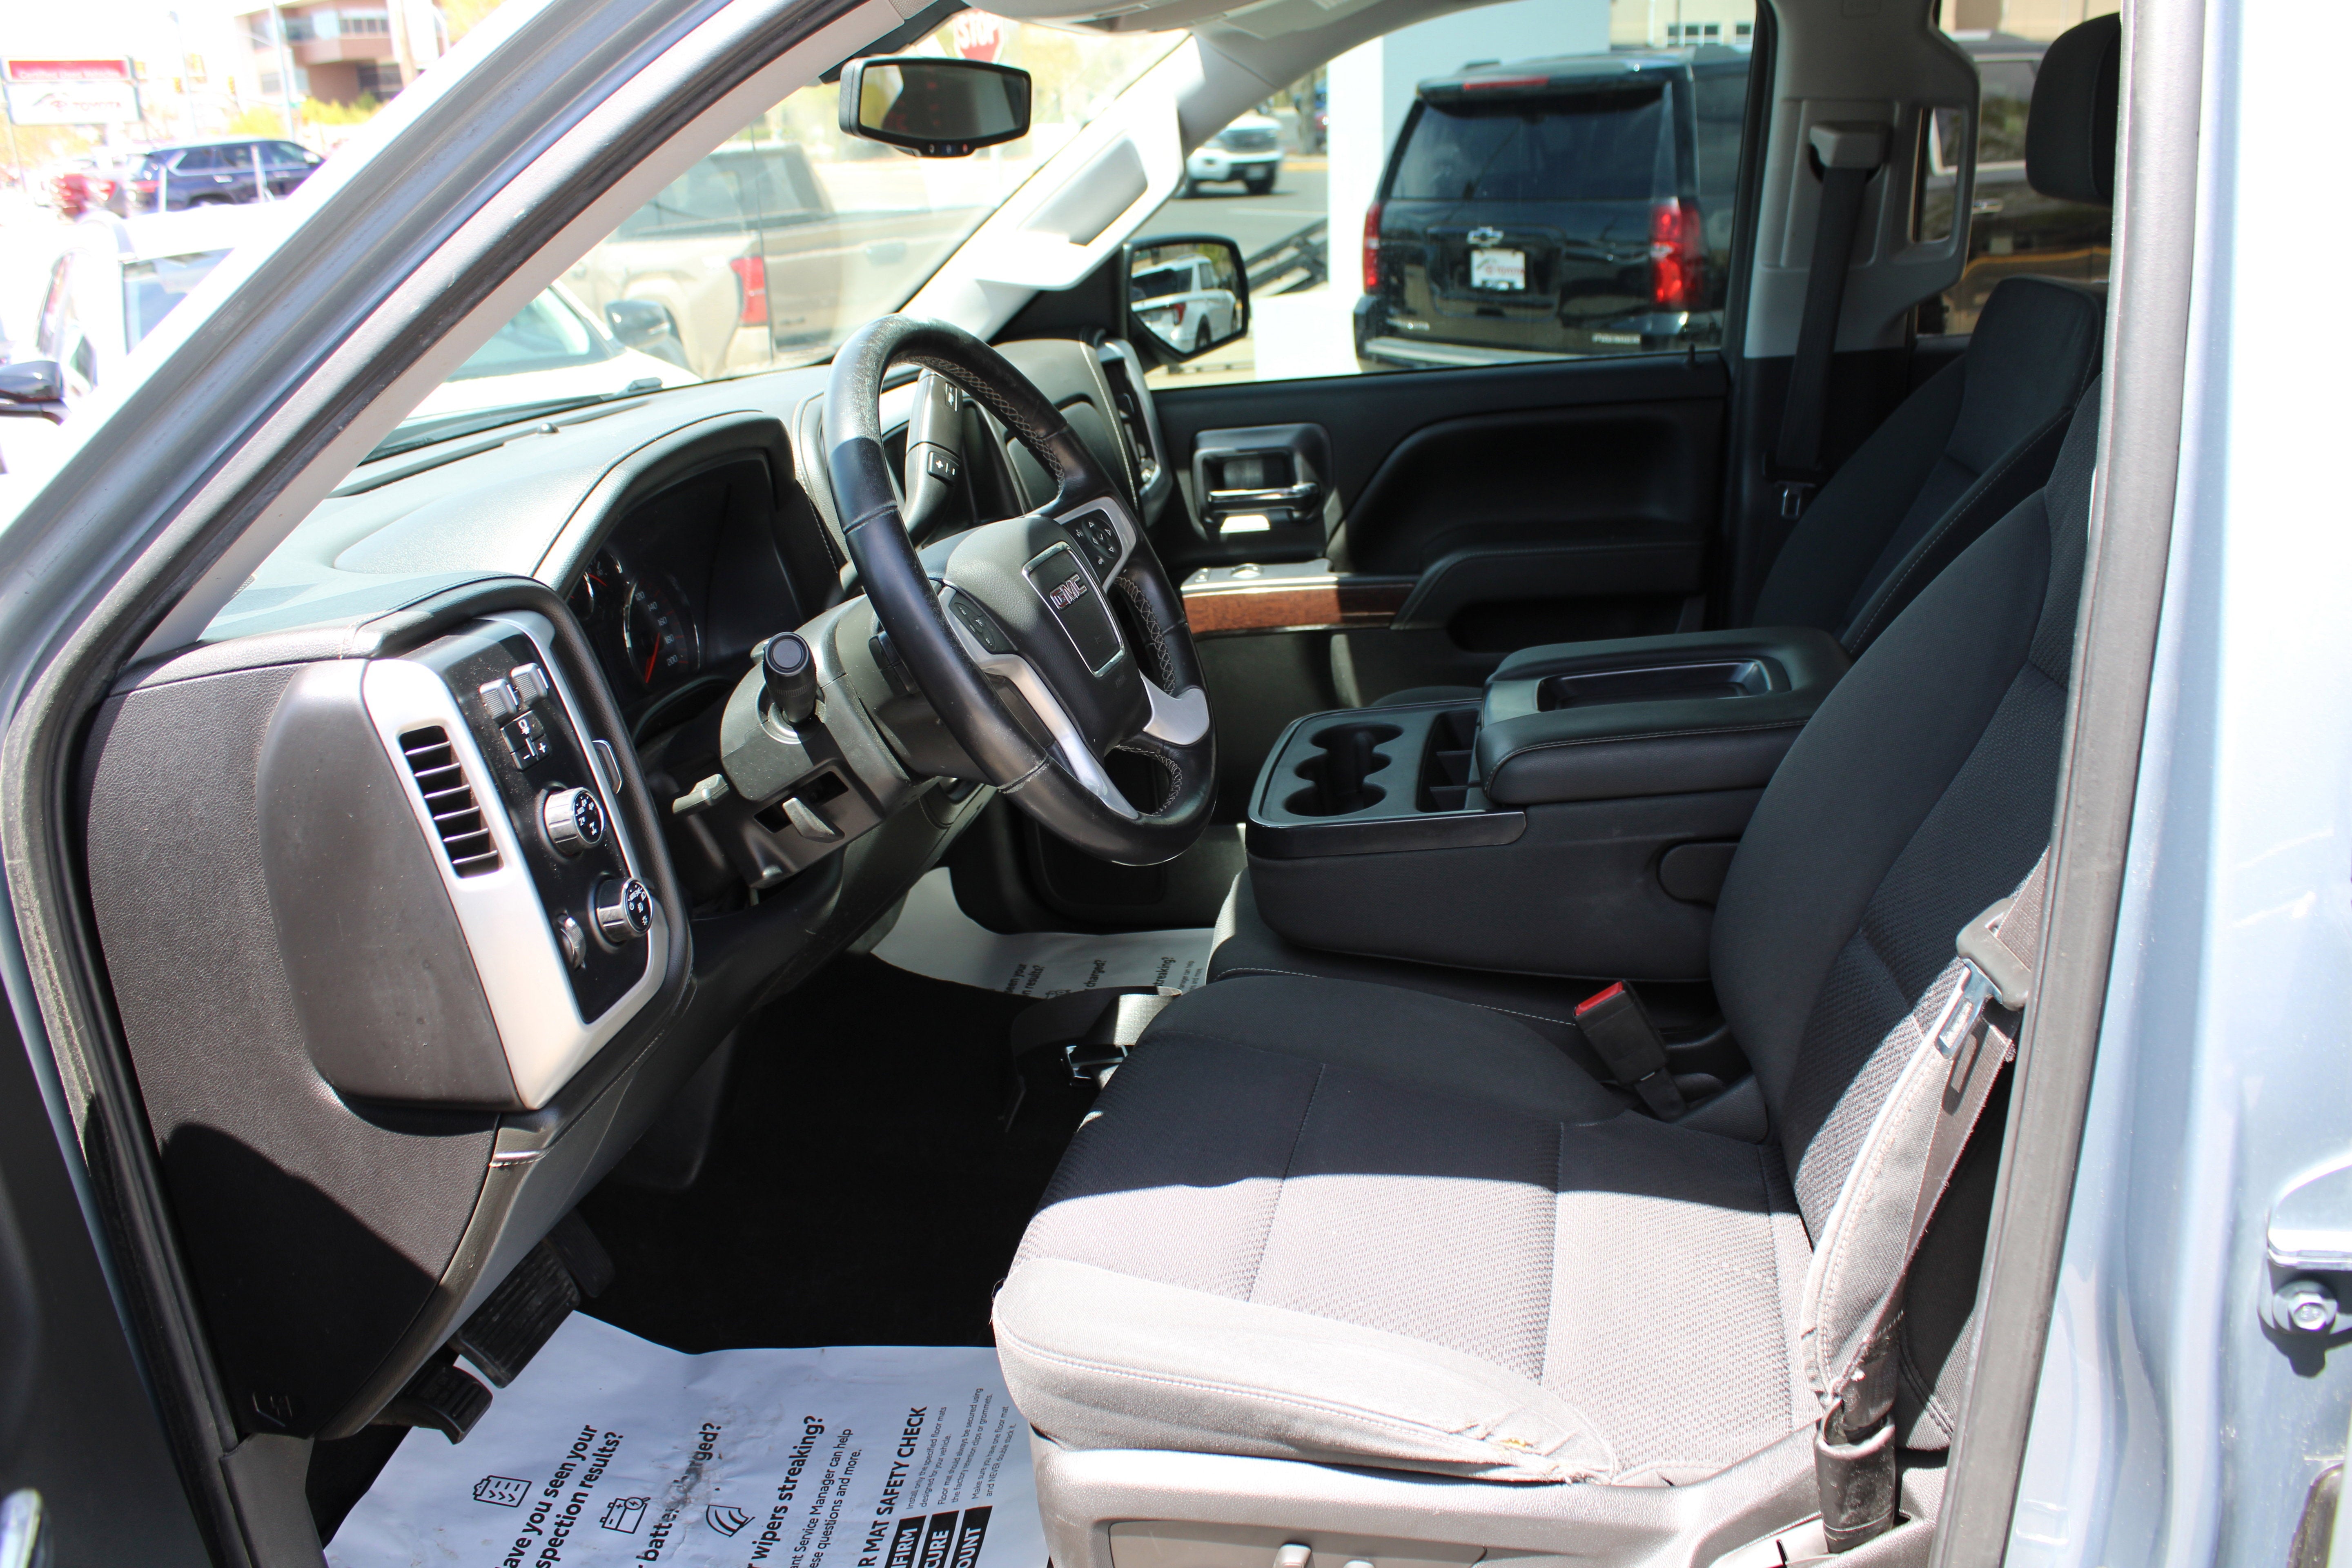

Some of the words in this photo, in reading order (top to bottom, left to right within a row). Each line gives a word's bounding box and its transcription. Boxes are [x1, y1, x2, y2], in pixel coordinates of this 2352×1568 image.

[957, 11, 999, 49] STOP
[72, 101, 122, 111] TOYOTA
[1050, 574, 1087, 610] GMC
[648, 601, 658, 612] 140
[657, 617, 668, 626] 160
[666, 655, 678, 666] 200
[1024, 965, 1045, 989] results?
[1083, 960, 1107, 987] charged?
[1153, 957, 1176, 986] treaking?
[973, 1388, 983, 1403] using
[938, 1407, 947, 1421] mats
[967, 1405, 977, 1429] secured
[833, 1429, 853, 1449] help
[931, 1423, 942, 1439] floor
[961, 1429, 969, 1438] be
[830, 1450, 843, 1467] can
[924, 1439, 938, 1466] specified
[956, 1439, 968, 1458] always
[972, 1481, 982, 1499] Make
[978, 1466, 987, 1480] sure
[987, 1444, 996, 1458] have
[994, 1419, 1004, 1433] floor
[579, 1432, 624, 1488] results?
[948, 1458, 960, 1475] should
[863, 1520, 890, 1552] MAT
[877, 1461, 909, 1515] SAFETY
[898, 1406, 927, 1458] CHECK
[919, 1466, 927, 1476] the
[920, 1477, 935, 1508] designed
[929, 1468, 938, 1478] for
[935, 1455, 943, 1469] your
[954, 1469, 969, 1490] factory
[989, 1462, 1001, 1483] NEVER
[751, 1506, 788, 1560] wipers
[778, 1416, 825, 1501] streaking?
[809, 1469, 835, 1515] Manager
[915, 1477, 925, 1489] only
[495, 1537, 532, 1568] ave
[522, 1501, 553, 1535] you
[544, 1462, 577, 1498] seen
[566, 1425, 597, 1461] your
[818, 1499, 843, 1550] questions
[837, 1478, 851, 1497] and
[844, 1449, 862, 1475] more.
[906, 1490, 918, 1509] Install
[938, 1485, 949, 1505] Floor
[952, 1491, 960, 1503] the
[795, 1518, 819, 1552] Service
[956, 1527, 981, 1568] OUNT
